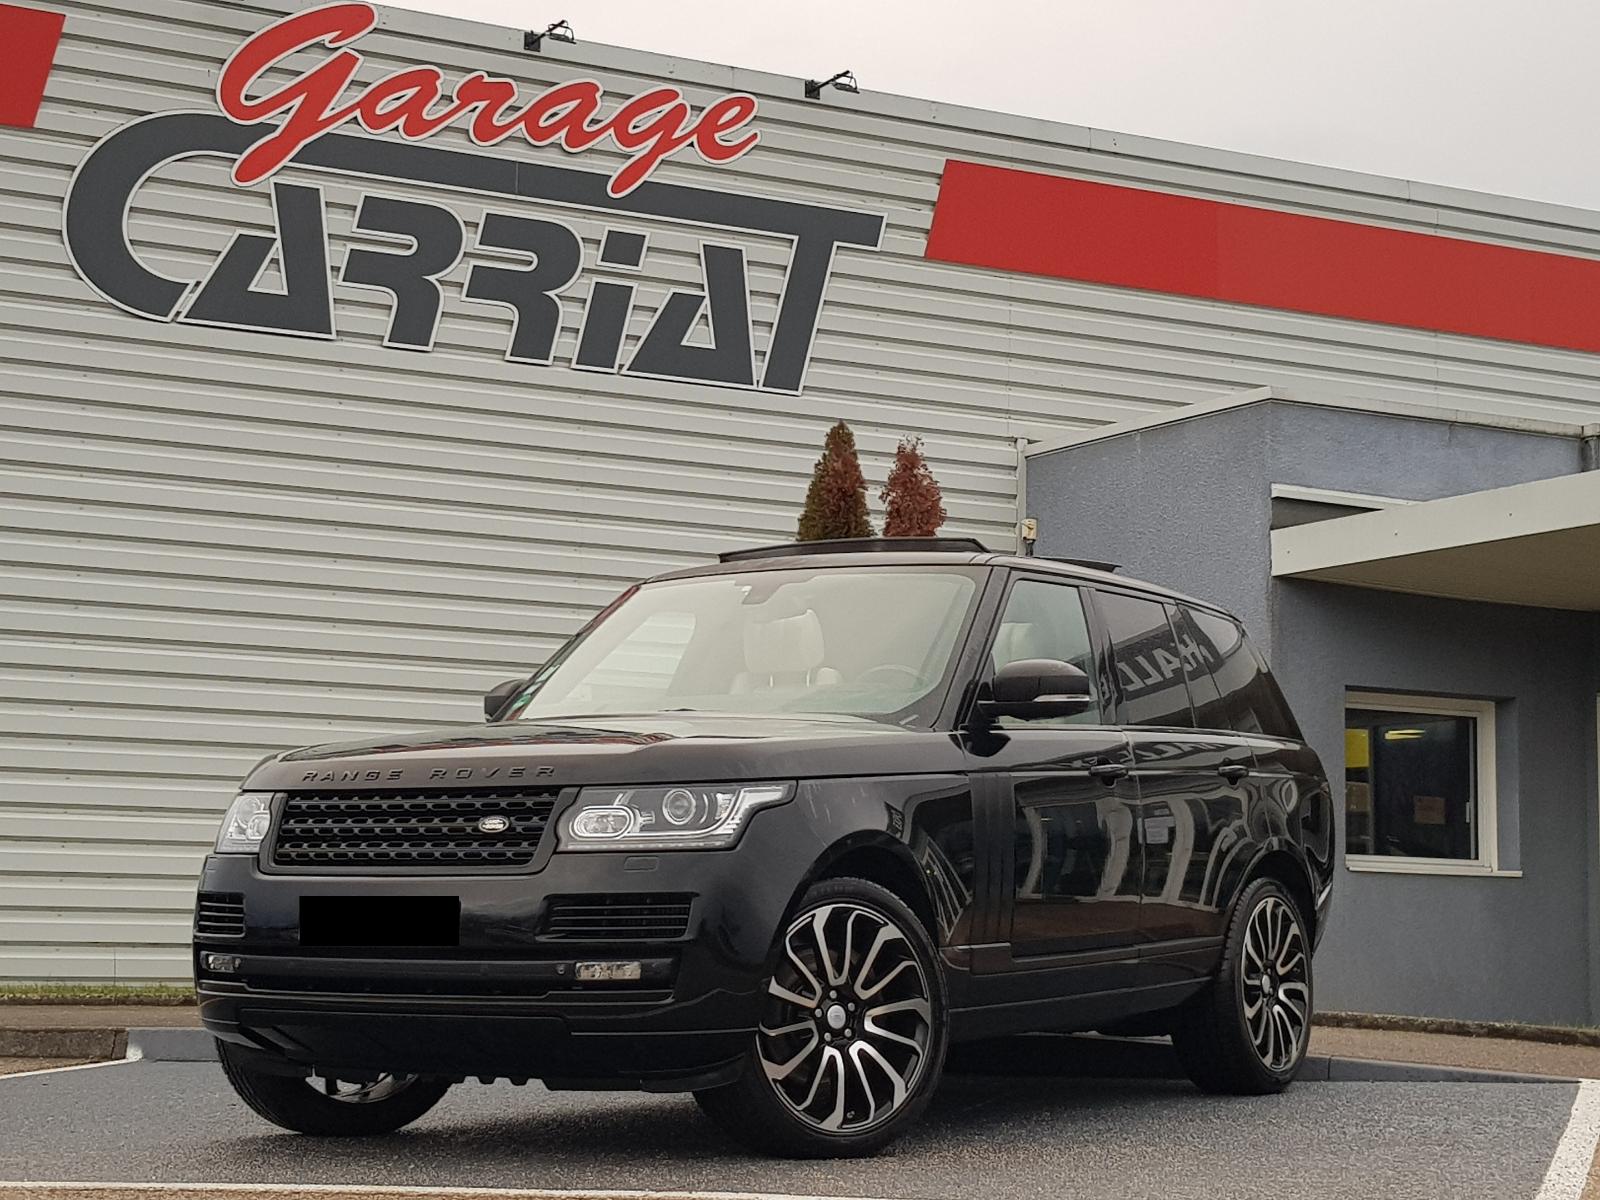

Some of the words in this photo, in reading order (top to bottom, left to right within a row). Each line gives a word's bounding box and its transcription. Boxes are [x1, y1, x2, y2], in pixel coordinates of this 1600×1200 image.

[216, 1, 760, 198] Garage
[302, 769, 403, 782] RANGE
[429, 765, 555, 780] ROVER
